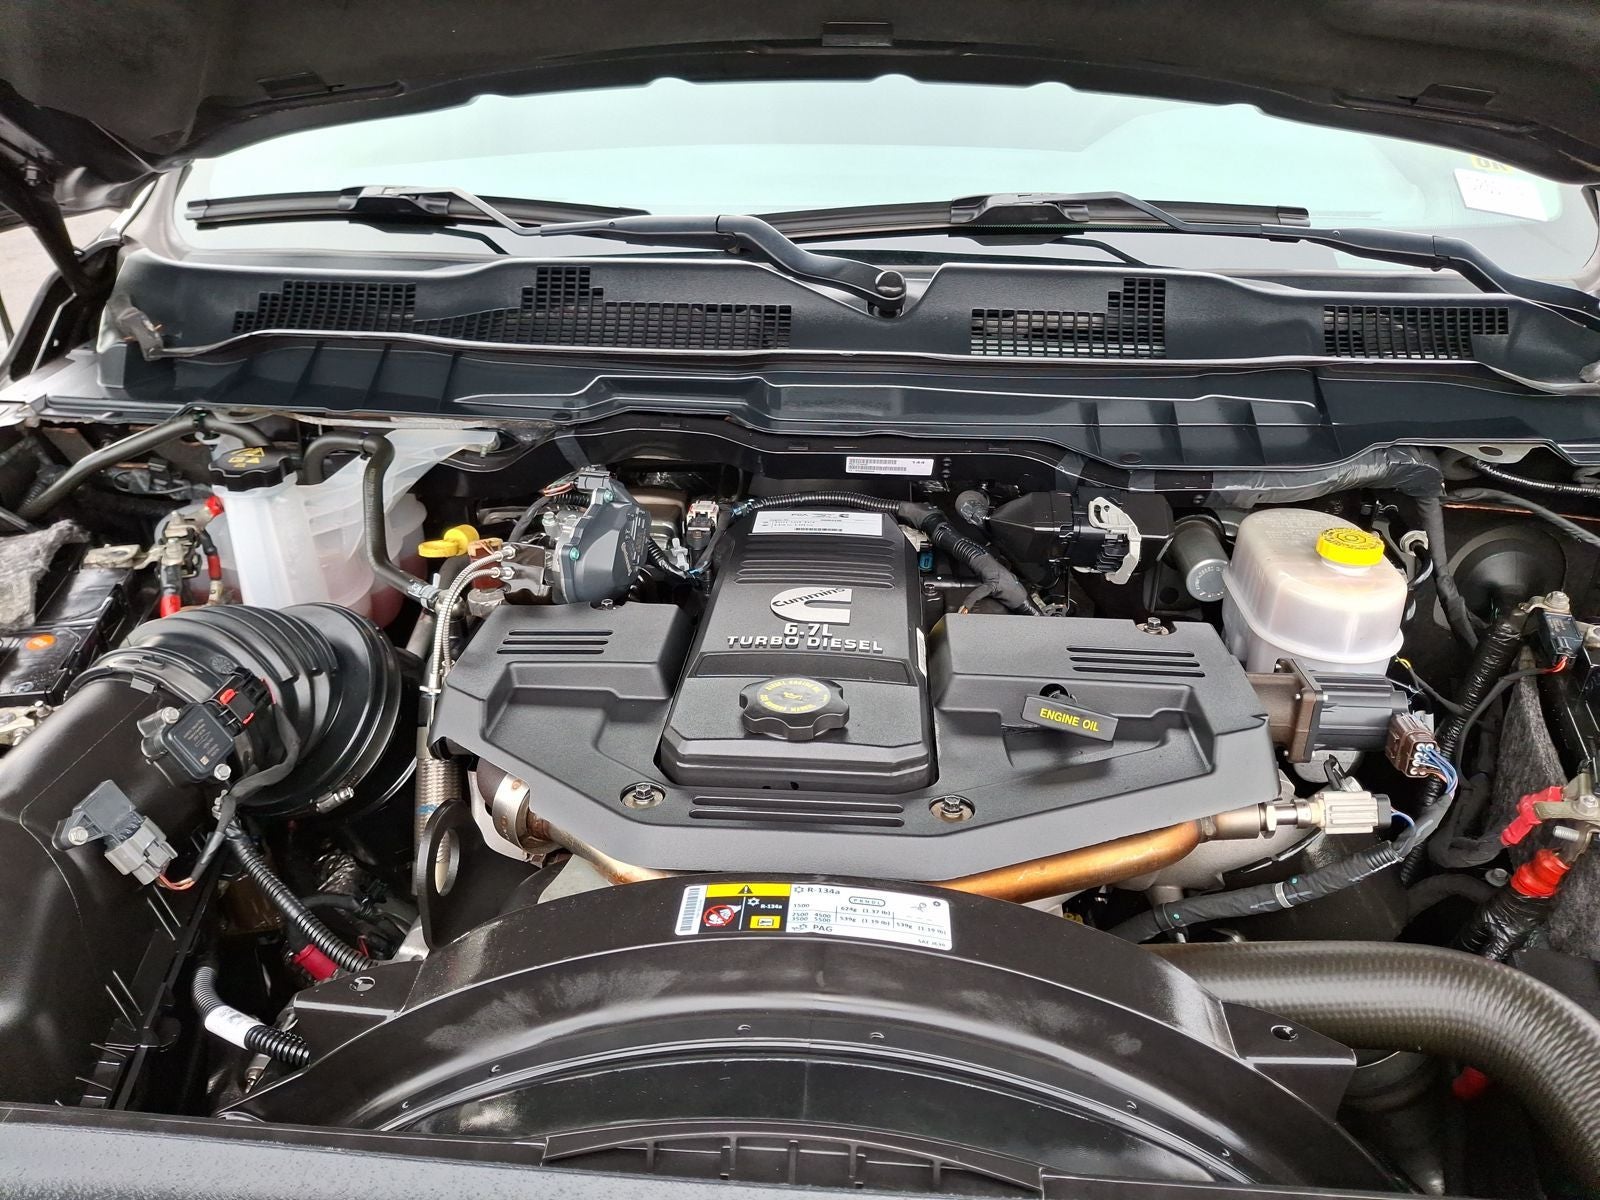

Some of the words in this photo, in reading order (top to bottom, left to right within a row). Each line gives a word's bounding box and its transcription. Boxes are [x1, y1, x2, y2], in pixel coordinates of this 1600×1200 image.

[771, 587, 846, 608] Cummins
[784, 622, 833, 638] 6.7L
[727, 635, 799, 649] TURBO
[806, 637, 884, 653] DIESEL
[1039, 707, 1080, 727] ENGINE
[1082, 719, 1099, 732] OIL
[807, 887, 841, 895] R-134a
[812, 923, 833, 933] PAG
